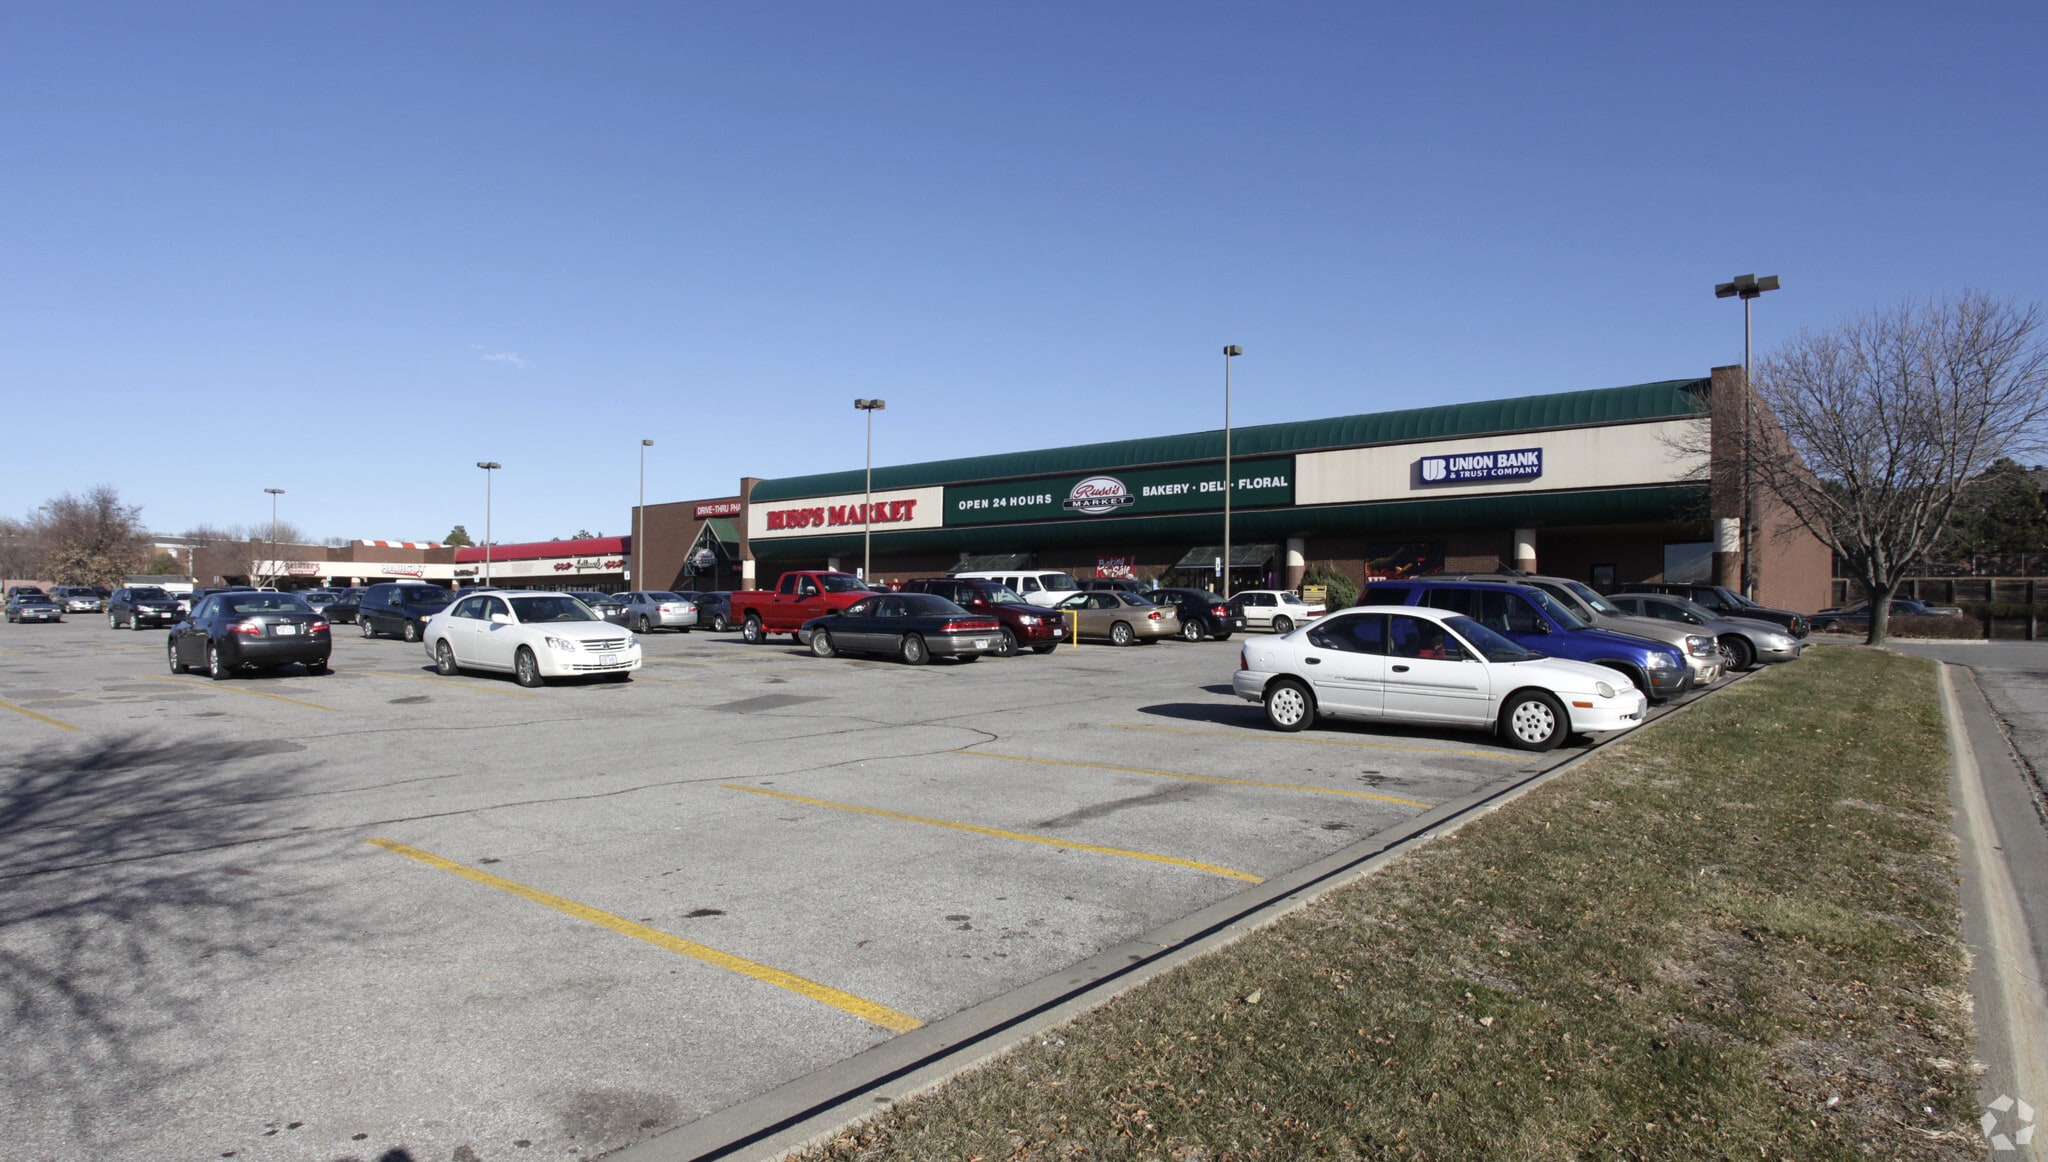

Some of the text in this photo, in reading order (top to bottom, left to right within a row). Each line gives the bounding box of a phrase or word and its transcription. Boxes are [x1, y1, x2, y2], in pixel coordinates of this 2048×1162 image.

[1449, 451, 1538, 471] UNION BANK
[1459, 469, 1488, 478] TRUST
[1491, 466, 1539, 476] COMPANY
[1073, 485, 1120, 499] Russ's
[1142, 483, 1189, 497] BAKERY
[1238, 476, 1288, 490] FLORAL
[697, 504, 729, 515] DRIVE-THRU
[958, 494, 1052, 510] OPEN 24 HOURS
[766, 499, 917, 530] RUSS'S MARKET
[1111, 565, 1131, 577] Sale
